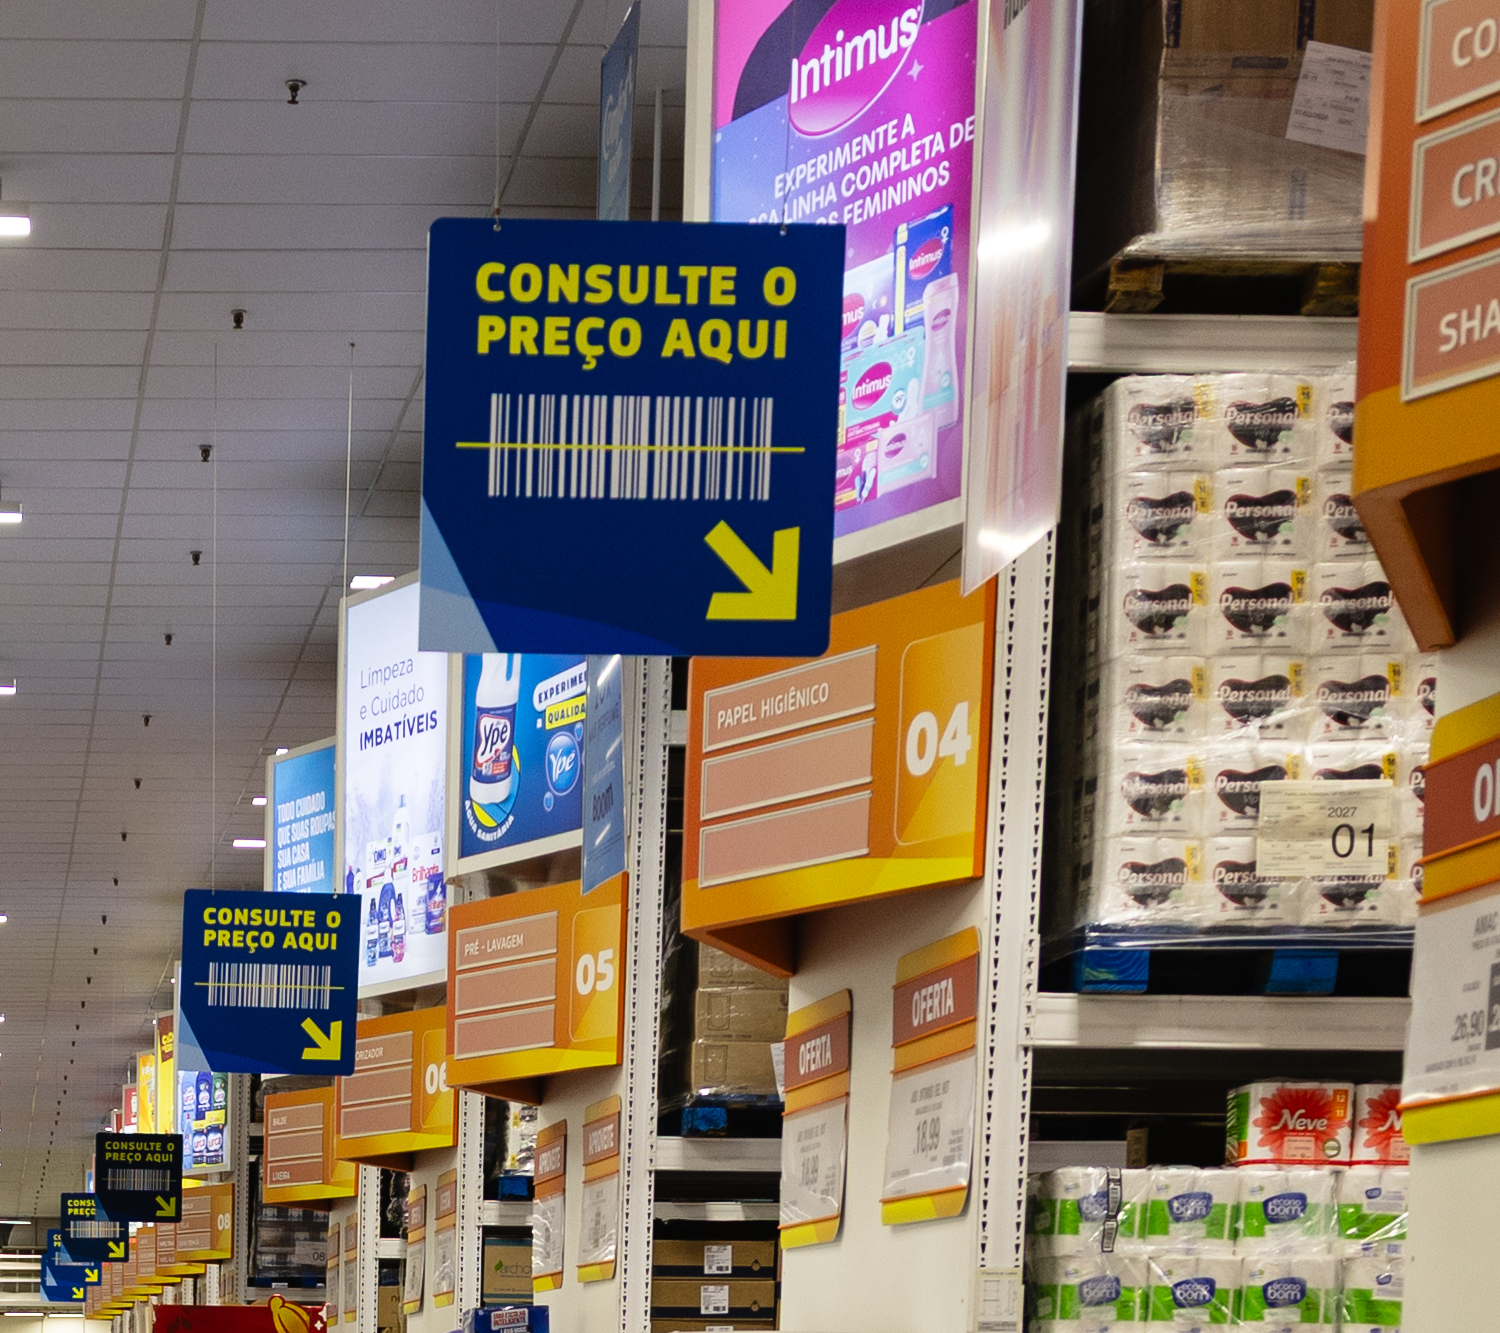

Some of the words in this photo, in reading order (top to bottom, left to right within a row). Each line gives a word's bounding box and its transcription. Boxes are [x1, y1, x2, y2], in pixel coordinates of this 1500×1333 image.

[791, 8, 918, 104] Intimus
[774, 118, 899, 200] EXPERIMENTE
[901, 113, 915, 139] A
[784, 183, 838, 224] LINHA
[840, 131, 945, 198] COMPLETA
[949, 116, 975, 151] DE
[843, 161, 950, 225] FEMININOS
[475, 262, 737, 306] CONSULTE
[762, 266, 797, 306] O
[476, 316, 643, 370] PREÇO
[661, 318, 788, 364] AQUI
[1224, 405, 1300, 428] Personal
[1224, 499, 1299, 521] Personal
[361, 659, 414, 690] Limpeza
[360, 705, 367, 719] e
[371, 685, 424, 716] Cuidado
[717, 697, 757, 731] PAPEL
[760, 677, 830, 720] HIGIÊNICO
[360, 710, 438, 751] IMBATÍVEIS
[482, 723, 508, 756] Ypê
[905, 701, 972, 777] 04
[550, 750, 575, 779] Ypê
[278, 802, 295, 825] TODO
[296, 791, 325, 819] CUIDADO
[1328, 806, 1357, 818] 2027
[278, 825, 290, 847] QUE
[291, 820, 309, 843] SUAS
[310, 811, 336, 838] ROUPAS
[1331, 823, 1375, 858] 01
[278, 848, 290, 870] SUA
[292, 842, 310, 866] CASA
[296, 857, 325, 884] FAMÍLIA
[203, 907, 317, 929] CONSULTE
[326, 910, 341, 929] O
[203, 929, 276, 954] PREÇO
[282, 931, 338, 953] AQUI
[465, 940, 480, 957] PRÉ
[487, 934, 524, 953] LAVAGEM
[576, 949, 615, 995] 05
[912, 980, 955, 1028] OFERTA
[799, 1033, 832, 1075] OFERTA
[273, 1116, 287, 1126] BALDE
[1275, 1109, 1328, 1132] Neve
[105, 1141, 162, 1151] CONSULTE
[167, 1142, 175, 1151] O
[105, 1152, 142, 1164] PREÇO
[146, 1153, 173, 1163] AQUI
[217, 1214, 230, 1231] 08
[312, 1252, 325, 1262] 08
